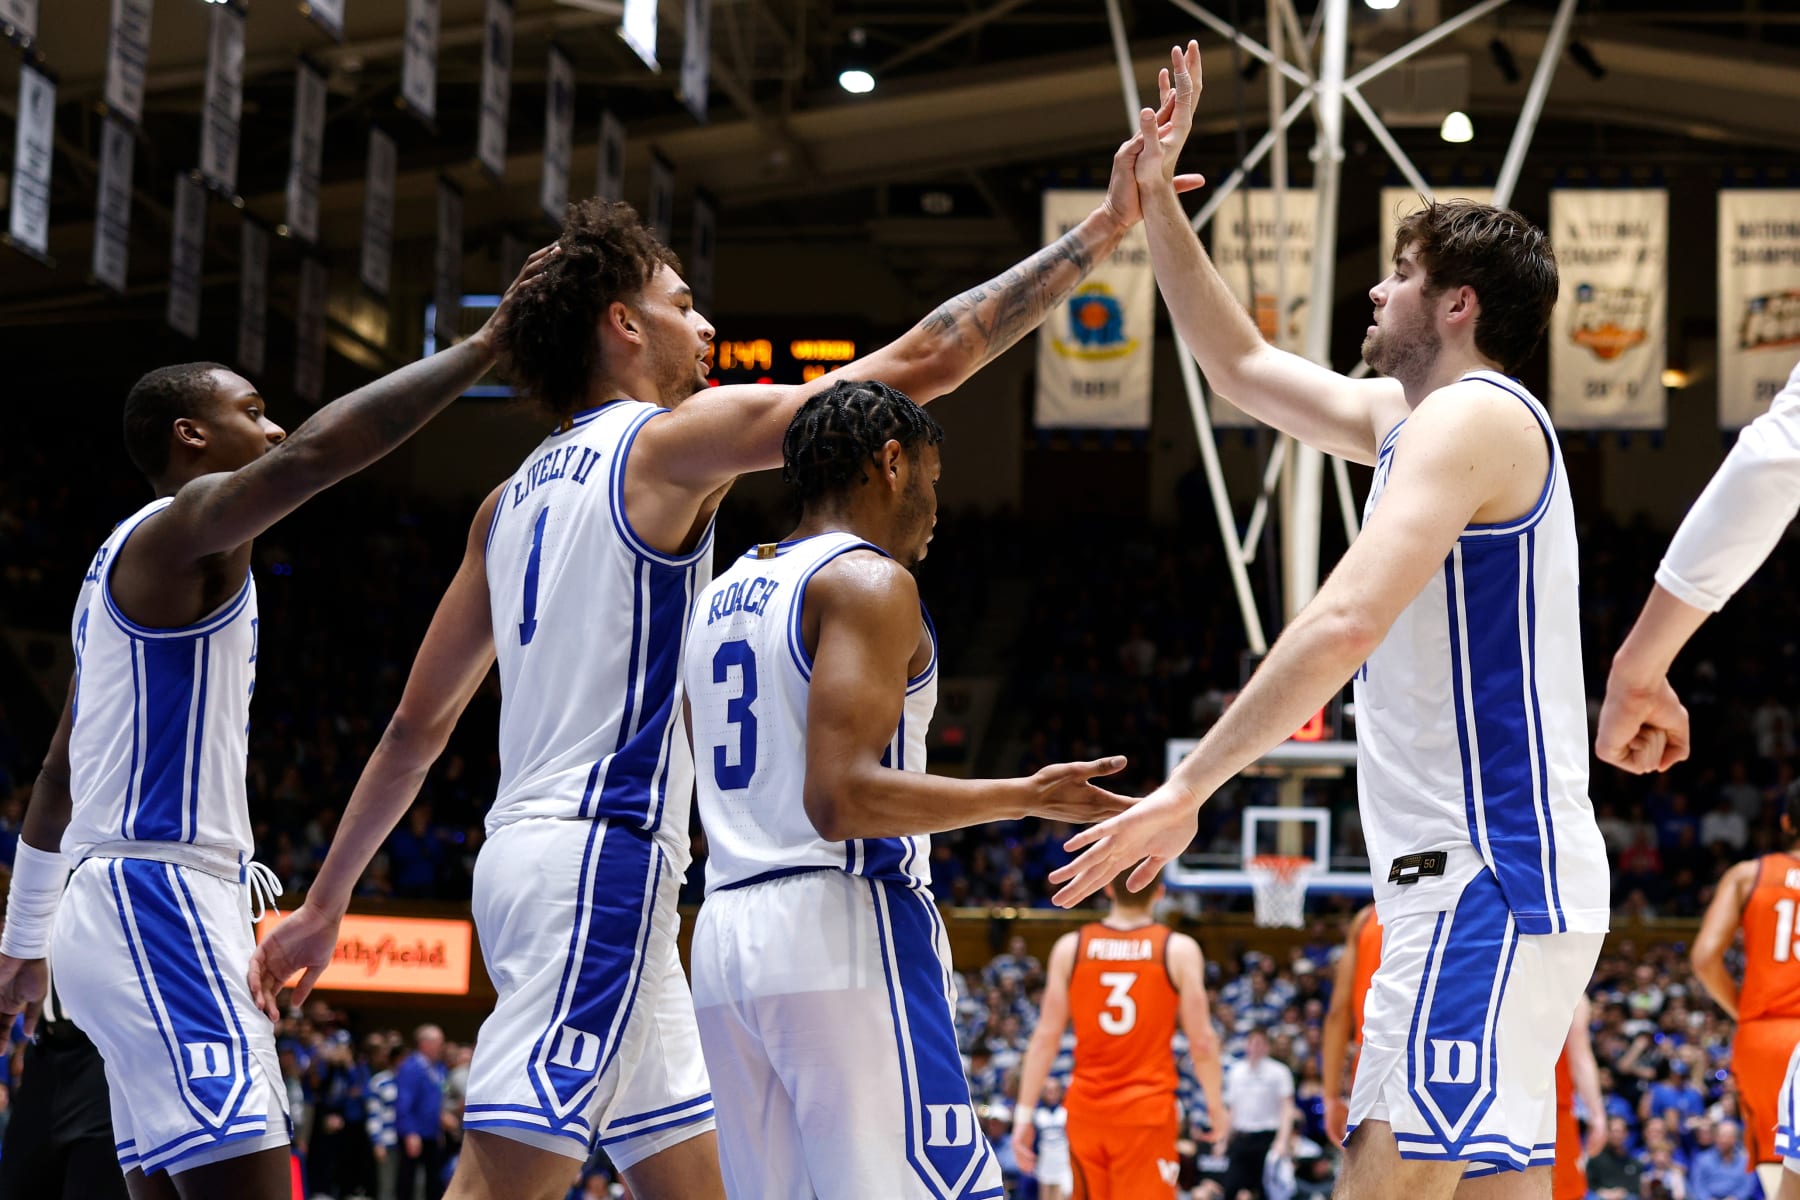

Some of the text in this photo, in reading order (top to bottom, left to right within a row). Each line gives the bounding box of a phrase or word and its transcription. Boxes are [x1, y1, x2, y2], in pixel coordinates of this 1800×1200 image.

[513, 445, 601, 509] LIVELY II
[519, 505, 549, 646] 1
[708, 576, 779, 626] ROACH
[713, 639, 757, 790] 3
[1424, 858, 1435, 869] 50
[1087, 938, 1152, 960] PEDULLA
[1774, 898, 1800, 962] 1
[332, 934, 448, 977] thfield
[1099, 971, 1137, 1035] 3
[183, 1042, 231, 1078] D
[550, 1024, 600, 1071] D
[1429, 1039, 1477, 1083] D
[925, 1104, 974, 1146] D
